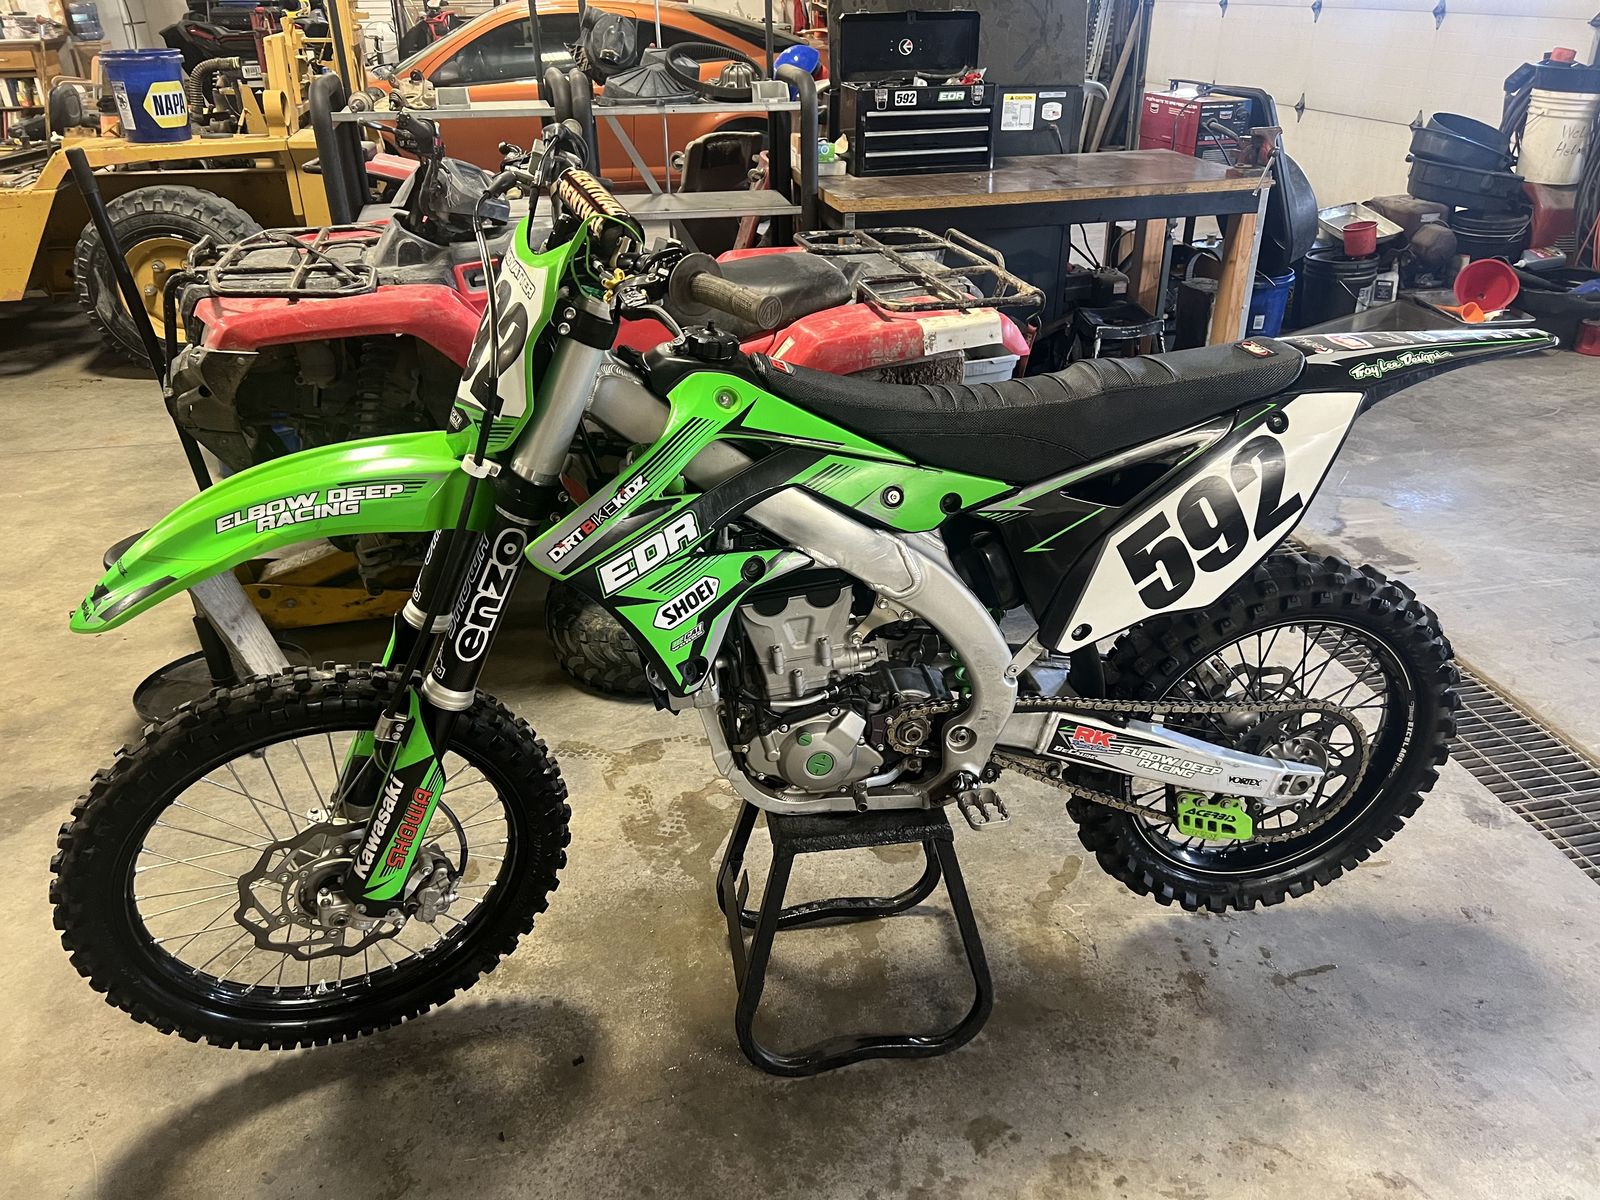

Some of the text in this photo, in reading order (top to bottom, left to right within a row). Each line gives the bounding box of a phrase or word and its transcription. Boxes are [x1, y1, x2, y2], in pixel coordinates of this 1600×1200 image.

[153, 93, 186, 116] NAPA
[897, 92, 916, 105] 592
[938, 91, 965, 101] EDR
[1350, 351, 1453, 379] Troy Lee Designs
[216, 483, 405, 534] ELBOW DEEP
[256, 500, 361, 533] RACING
[1116, 435, 1304, 610] 592
[599, 513, 699, 595] EDR
[455, 528, 528, 662] enzo
[661, 580, 714, 625] SHOEI
[1073, 725, 1117, 749] RK
[1120, 746, 1180, 764] ELBOW
[1180, 760, 1223, 775] DEEP
[1137, 759, 1195, 778] RACING
[1228, 776, 1262, 787] VORTEX
[353, 773, 404, 880] Kawasaki
[386, 787, 433, 870] SHOWA
[1184, 807, 1237, 823] ACERBIS
